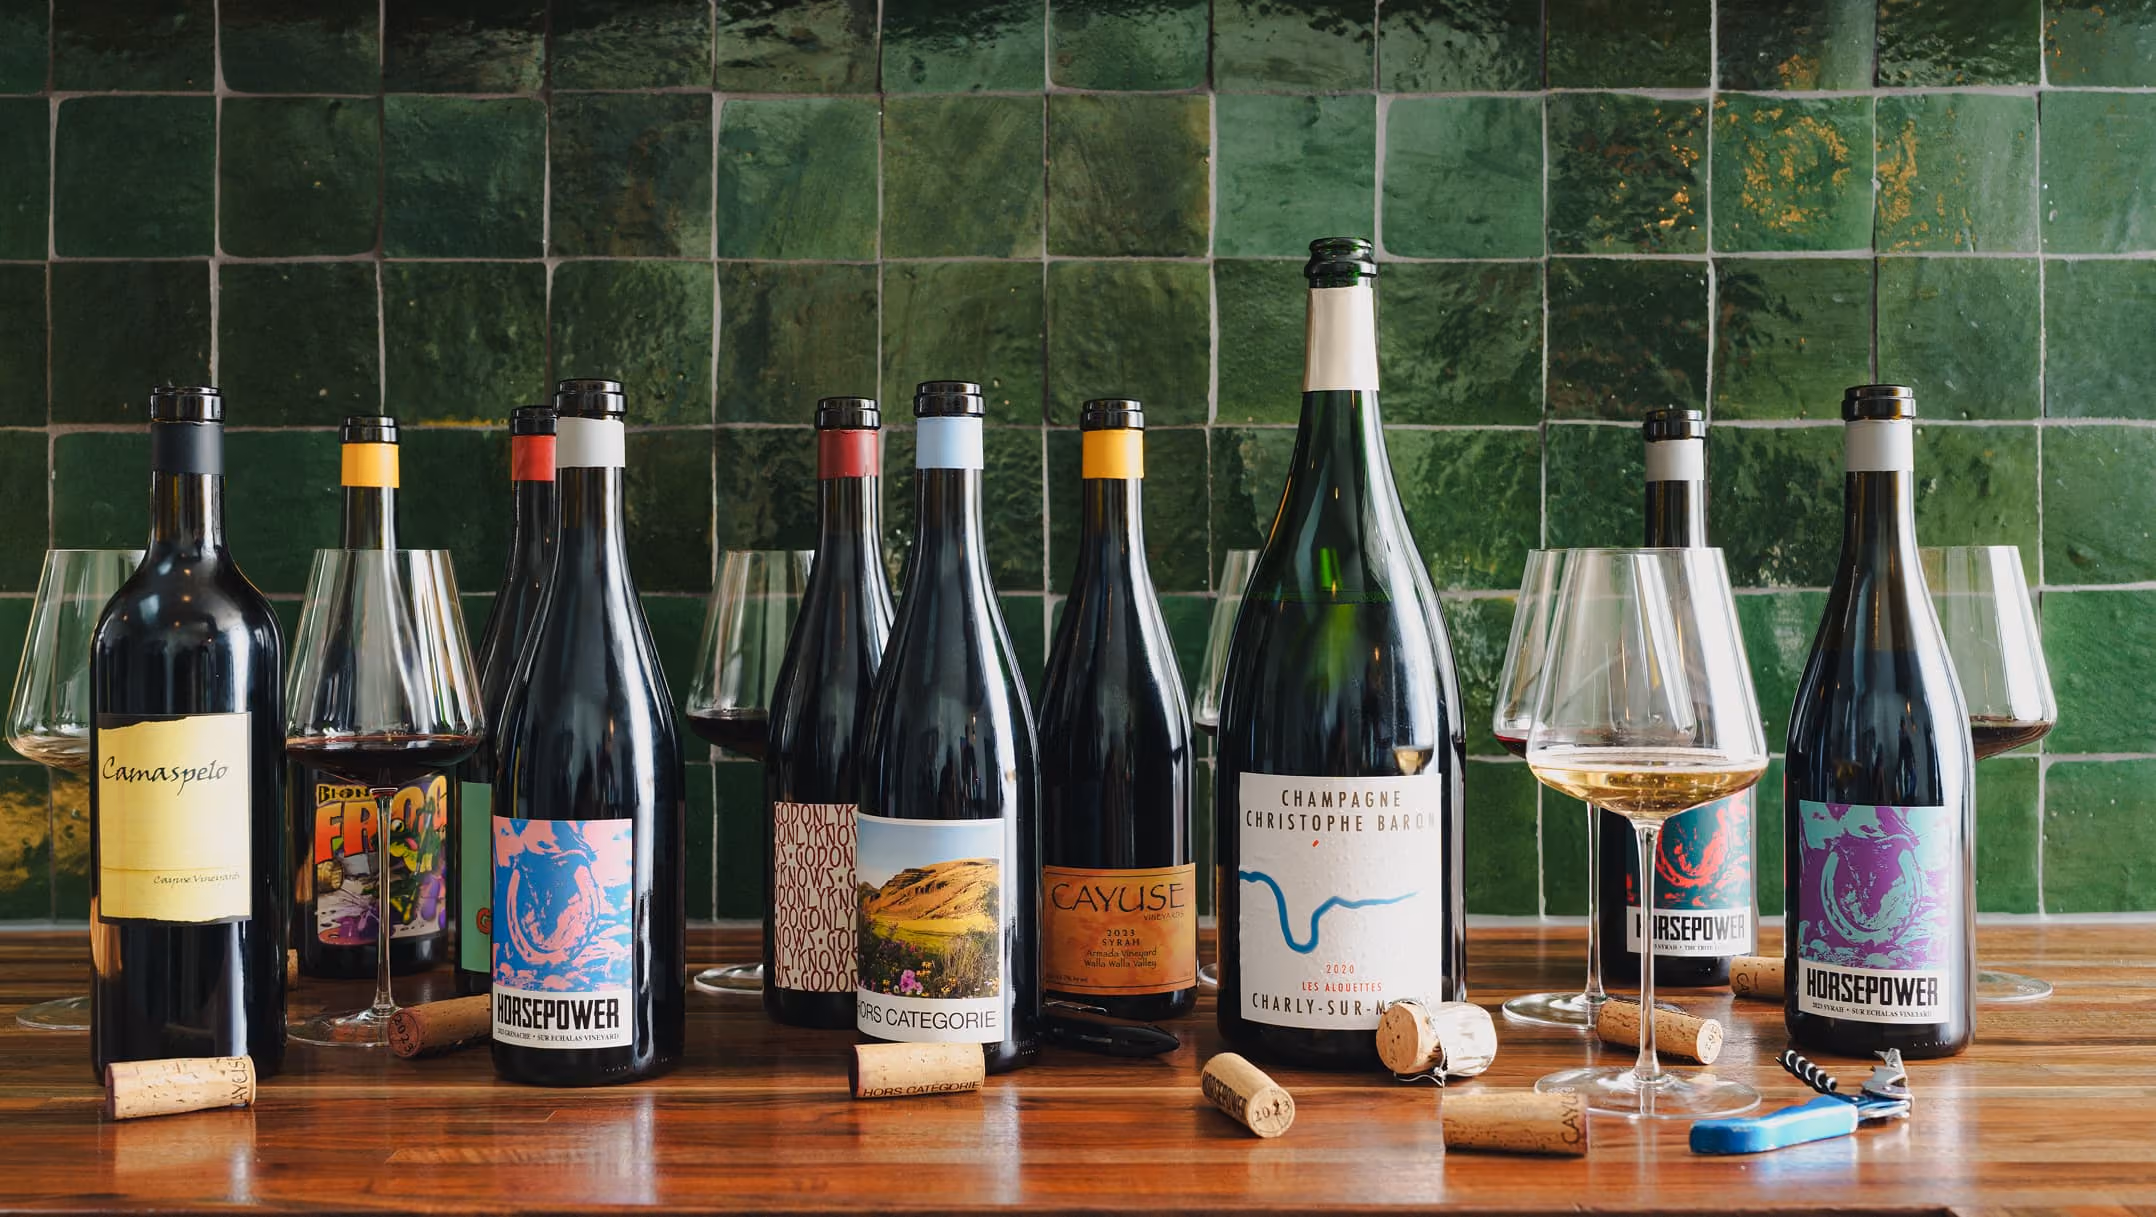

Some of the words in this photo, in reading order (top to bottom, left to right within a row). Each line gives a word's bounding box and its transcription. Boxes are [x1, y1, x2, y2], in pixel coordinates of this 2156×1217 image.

[102, 755, 229, 796] Camaspelo
[1281, 790, 1401, 808] CHAMPAGNE
[1246, 810, 1363, 832] CHRISTOPHE
[1377, 812, 1435, 831] BARON
[1051, 883, 1185, 913] CAYUSE
[1106, 929, 1136, 937] 2023
[1102, 938, 1141, 946] SYRAH
[1086, 949, 1119, 957] Armada
[1120, 947, 1157, 960] Vineyard
[1084, 959, 1106, 968] Walla
[1108, 959, 1130, 968] Walla
[1133, 959, 1157, 969] Valley
[1326, 964, 1355, 974] 2020
[1302, 981, 1319, 991] LES
[1325, 982, 1382, 992] ALOUETTES
[1807, 968, 1938, 1006] HORSEPOWER
[497, 993, 619, 1030] HORSEPOWER
[857, 1002, 882, 1023] ORS
[886, 1008, 996, 1029] CATEGORIE
[1823, 1004, 1844, 1013] SYRAH
[1851, 1007, 1864, 1015] SUR
[505, 1029, 531, 1039] GRENACHE
[863, 1087, 902, 1097] HORS
